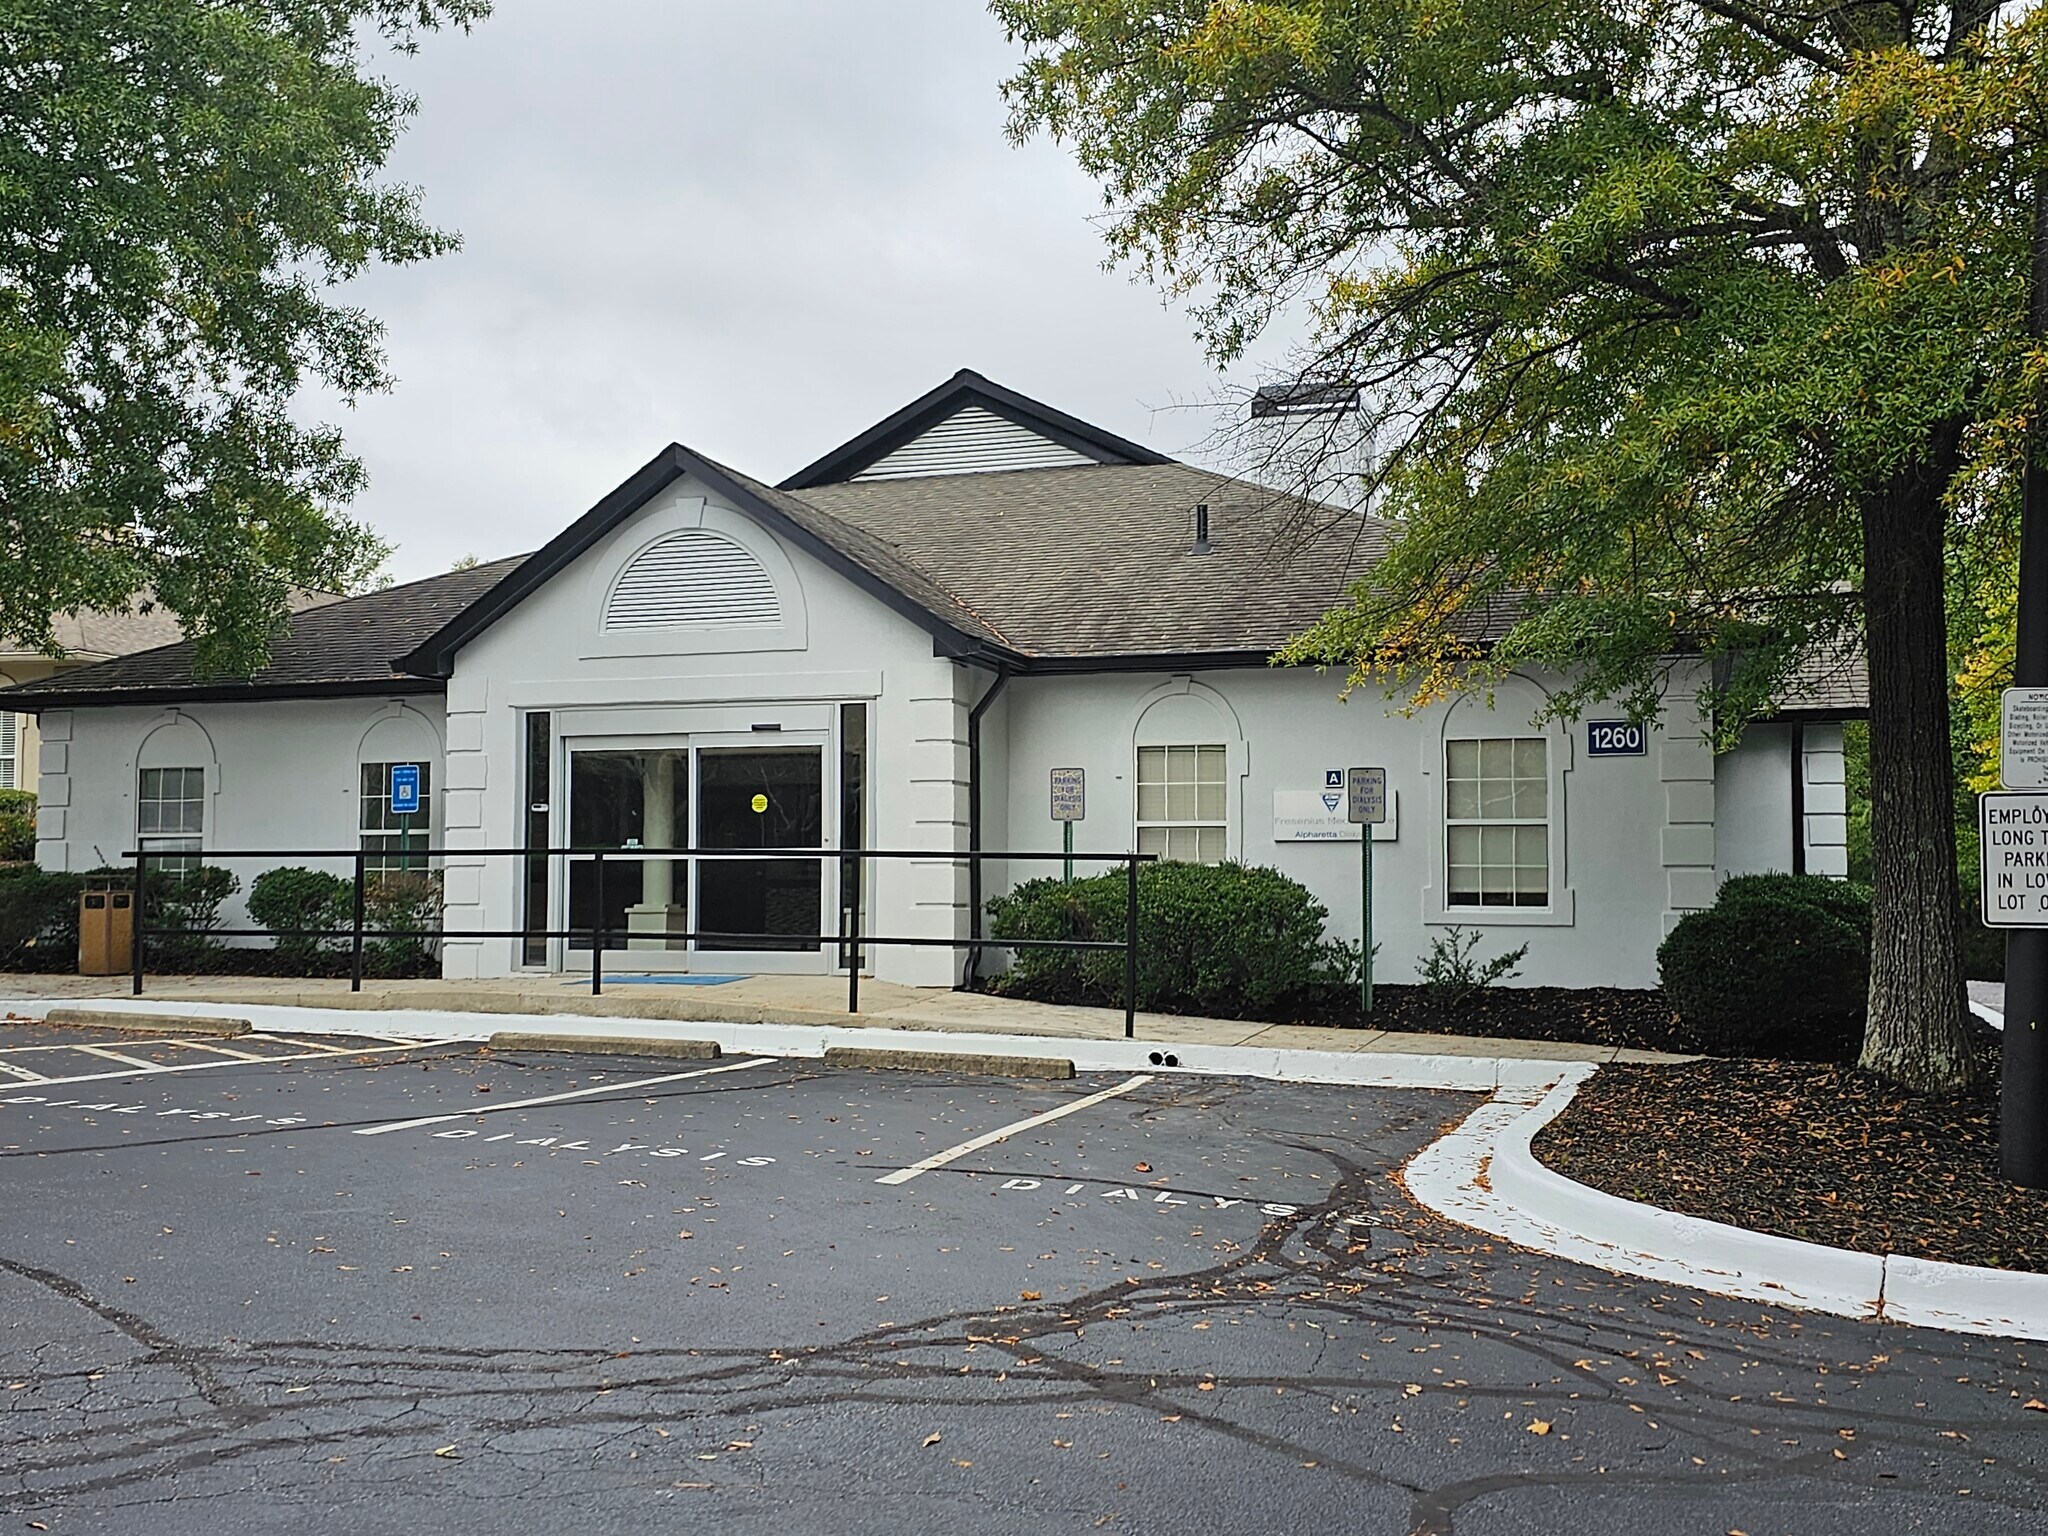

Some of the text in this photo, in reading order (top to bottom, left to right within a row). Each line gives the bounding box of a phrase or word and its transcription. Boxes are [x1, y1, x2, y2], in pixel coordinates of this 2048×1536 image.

[1591, 727, 1640, 748] 1260
[1329, 773, 1339, 783] A
[1993, 830, 2034, 845] LONG
[1998, 873, 2048, 888] IN LO
[1999, 895, 2026, 909] LOT
[5, 1096, 307, 1125] DIALYSIS
[432, 1129, 777, 1166] DIALYSIS
